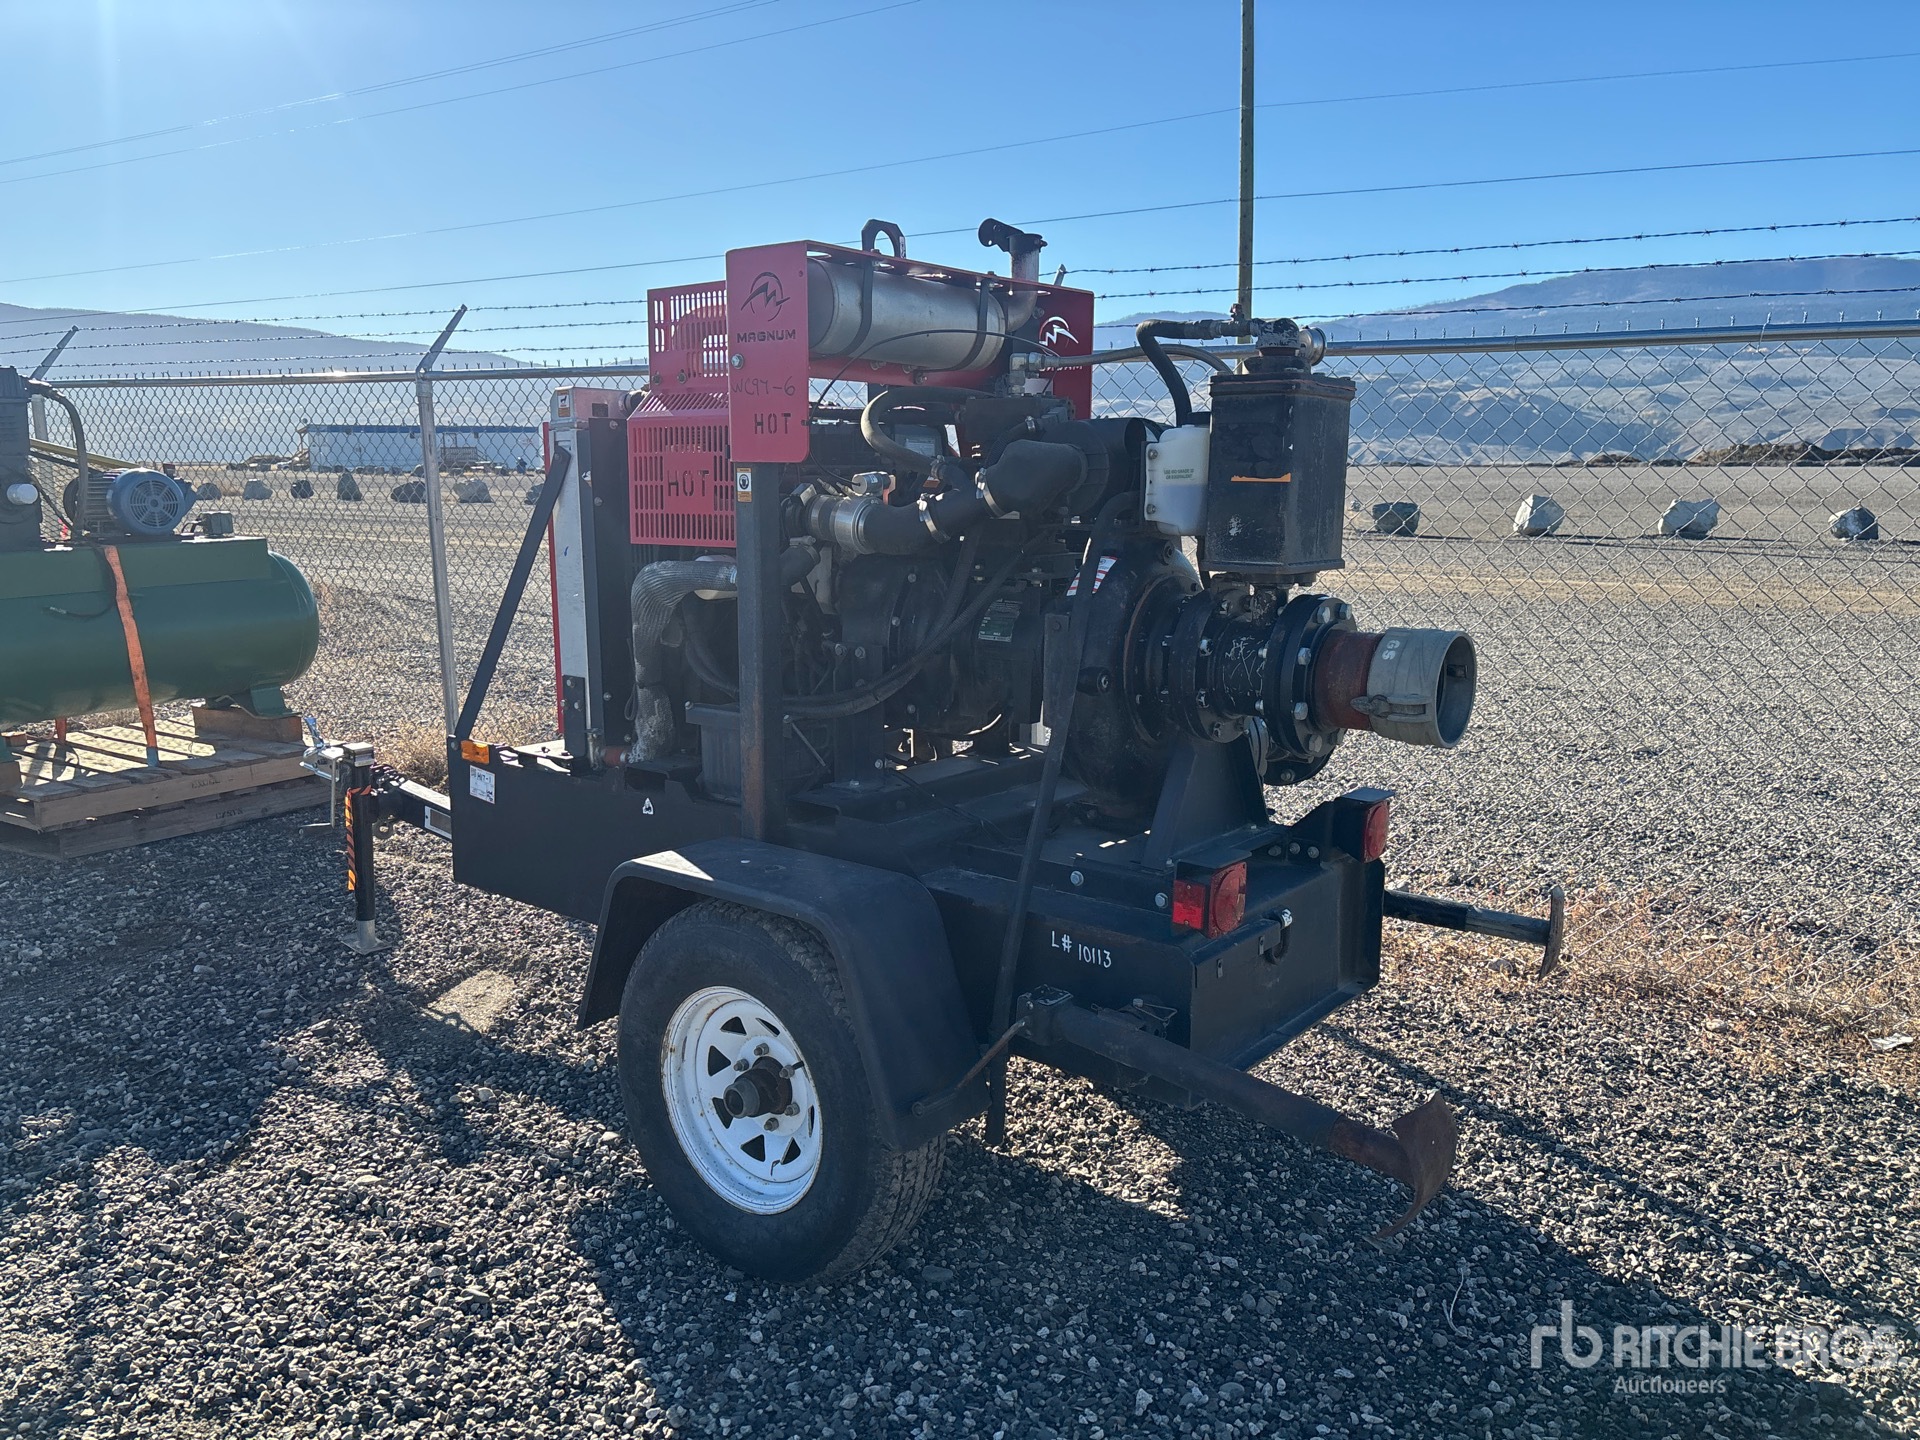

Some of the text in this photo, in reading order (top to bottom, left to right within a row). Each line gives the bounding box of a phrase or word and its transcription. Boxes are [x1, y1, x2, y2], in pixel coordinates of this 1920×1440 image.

[736, 329, 796, 343] MAGNUM
[754, 412, 792, 435] HOT
[667, 469, 710, 497] HOT
[1051, 930, 1112, 969] L# 10113
